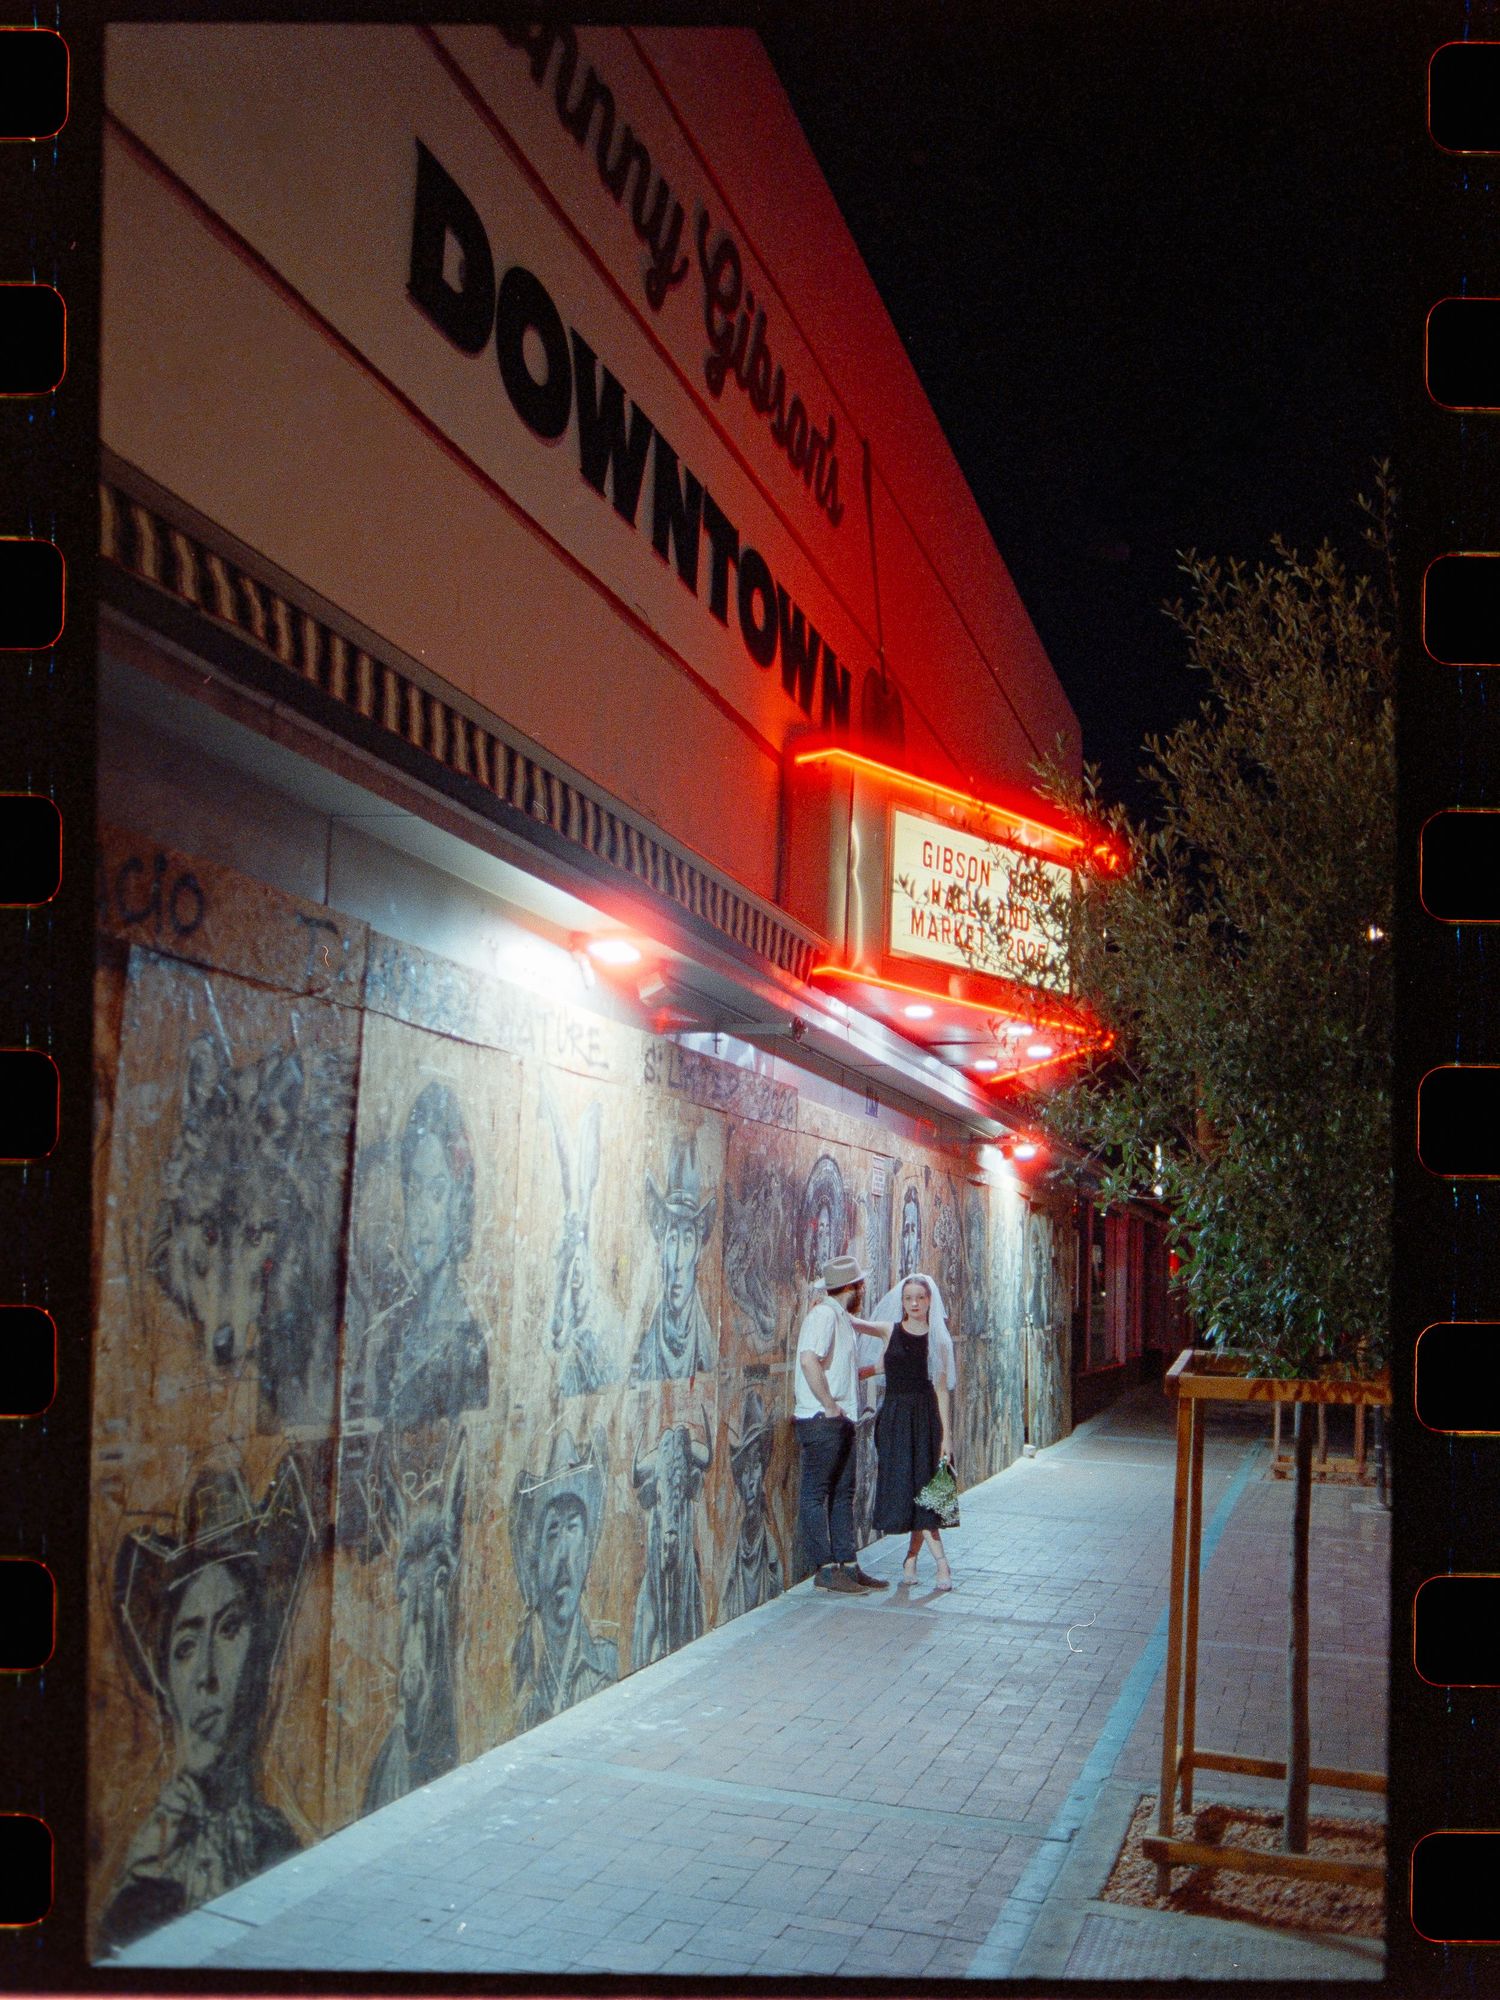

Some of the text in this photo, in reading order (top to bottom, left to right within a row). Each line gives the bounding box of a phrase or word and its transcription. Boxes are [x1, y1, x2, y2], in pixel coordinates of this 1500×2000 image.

[692, 197, 847, 527] Gibson's
[406, 137, 850, 734] DOWNTOWN
[921, 840, 993, 888] GIBSON
[931, 878, 1031, 932] HALL AND
[910, 907, 1048, 969] MARKET 2025
